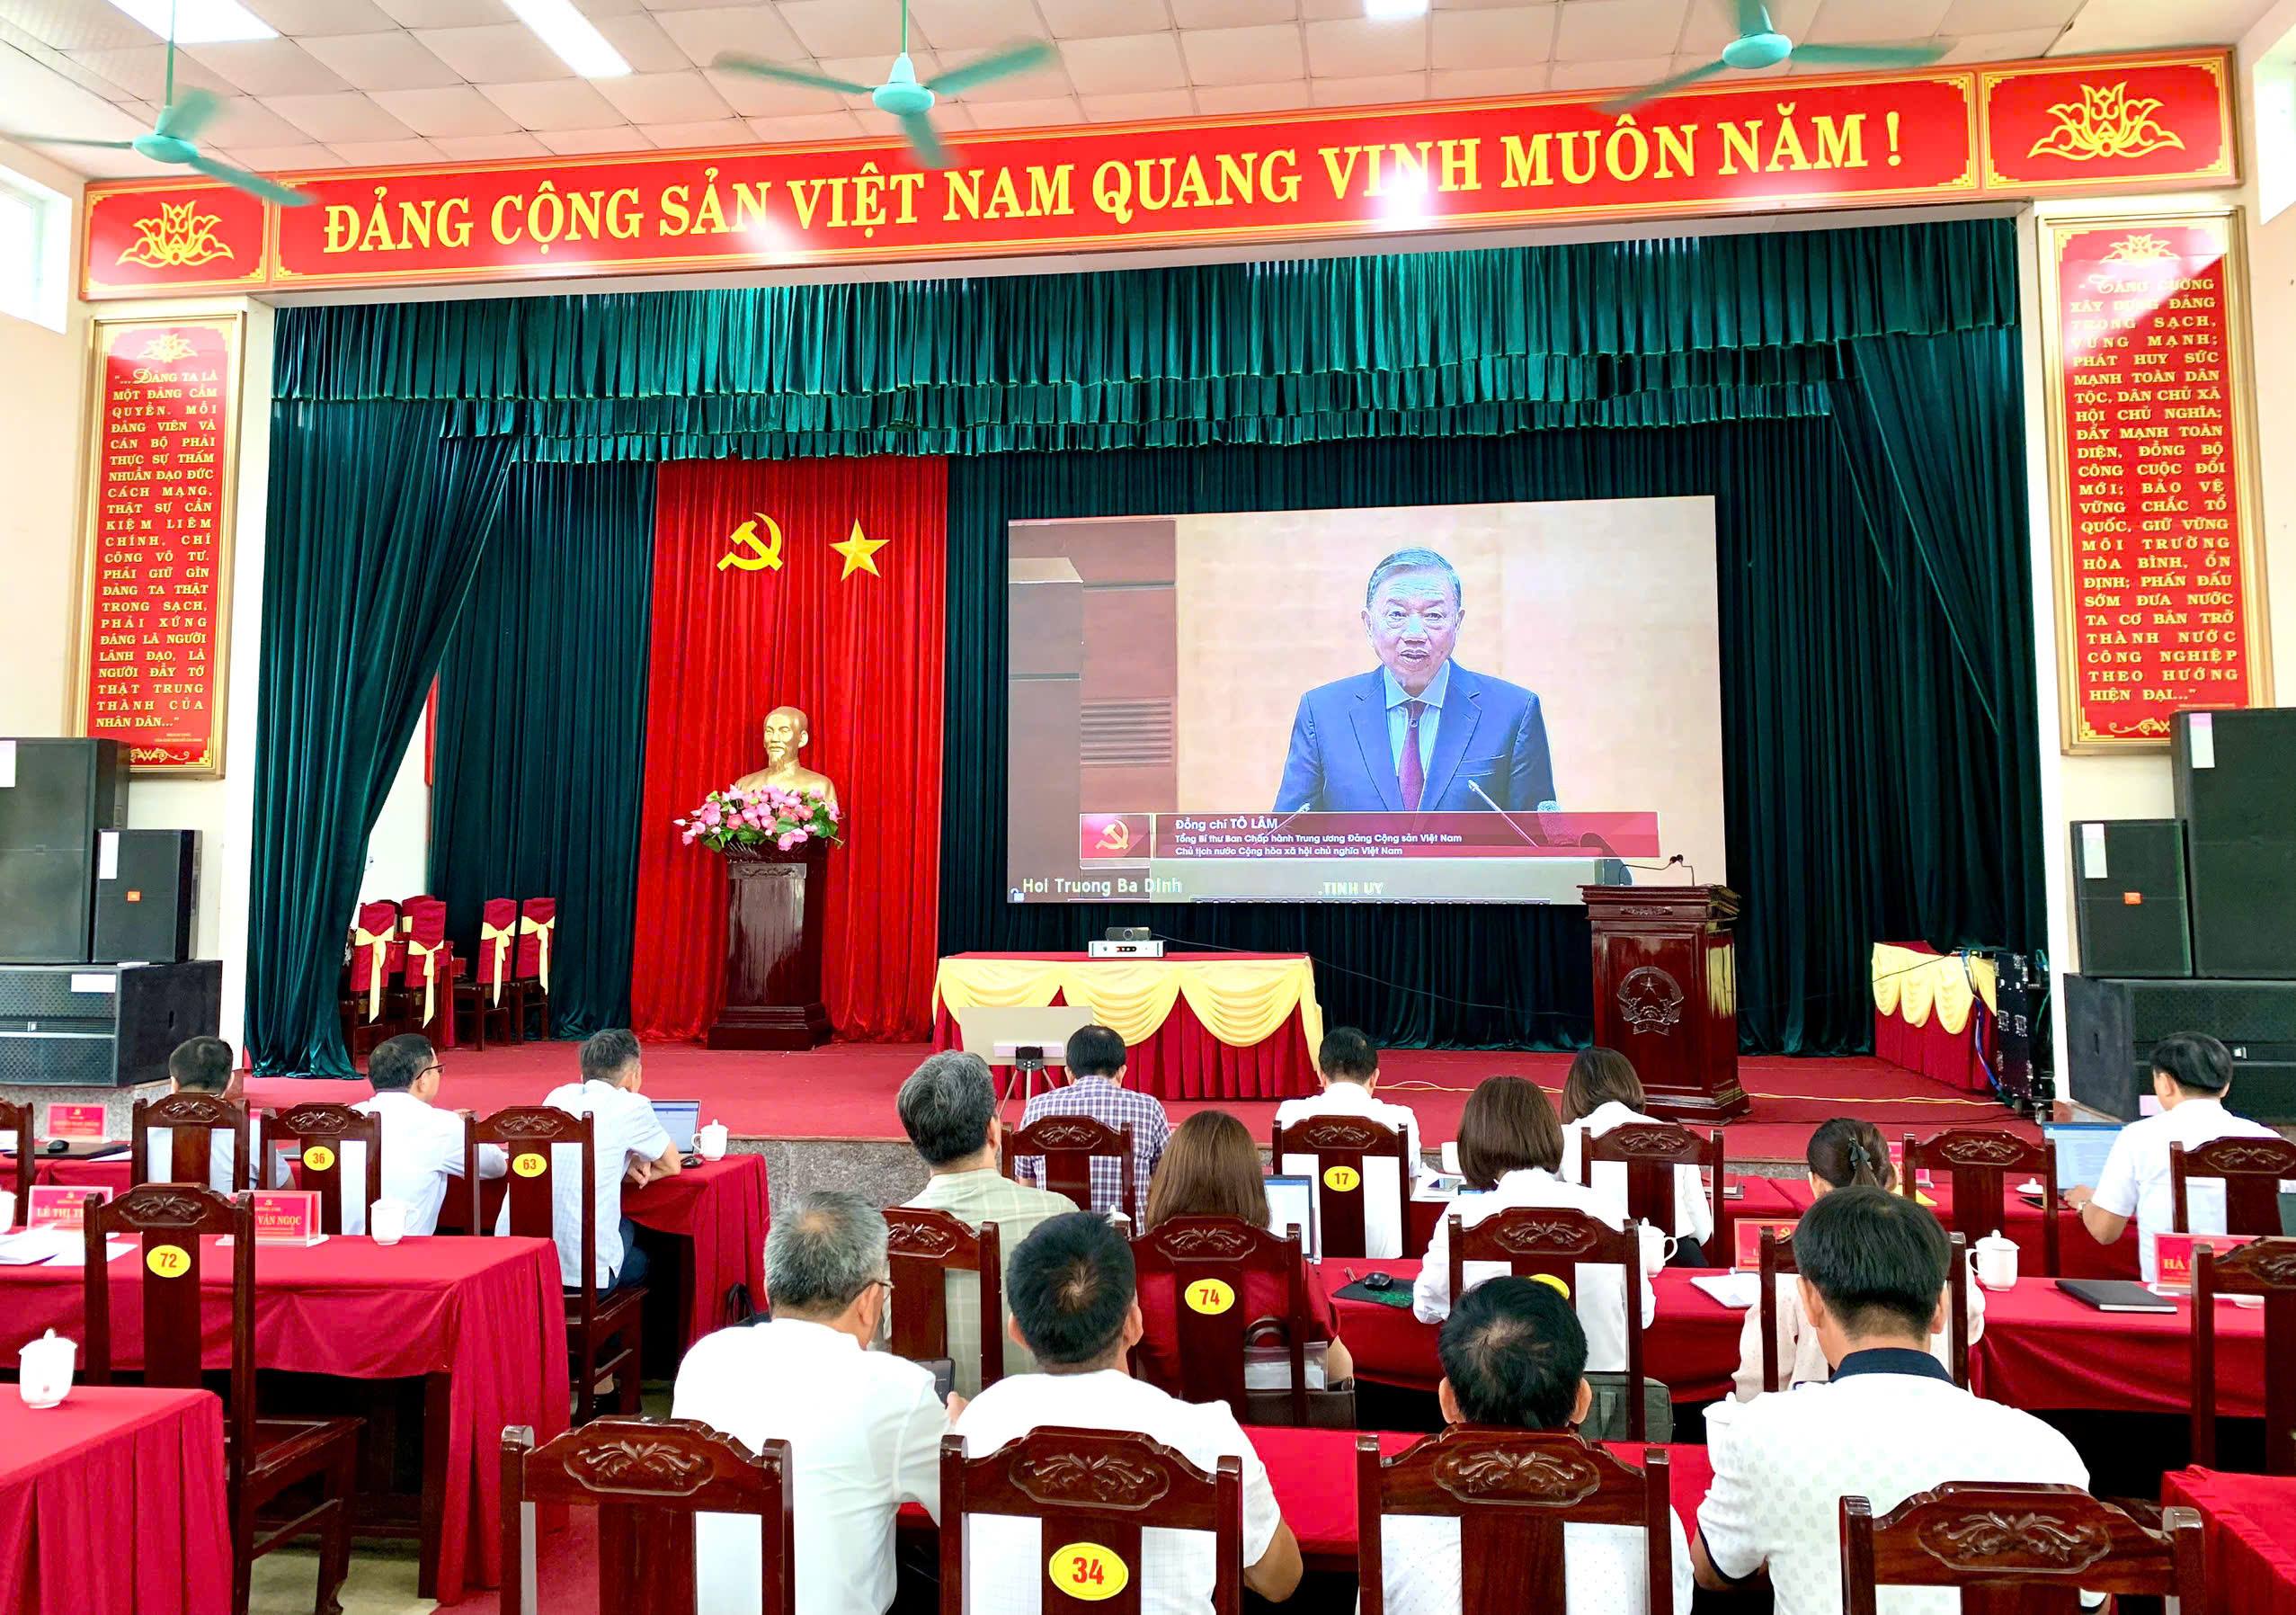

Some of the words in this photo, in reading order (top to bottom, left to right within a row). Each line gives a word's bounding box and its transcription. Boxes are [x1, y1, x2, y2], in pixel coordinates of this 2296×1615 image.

[323, 186, 474, 254] ĐẢNG
[491, 181, 644, 255] CỘNG
[659, 167, 775, 236] SẢN
[786, 162, 924, 238] VIỆT
[943, 165, 1074, 221] NAM
[1092, 149, 1302, 224] QUANG
[1318, 138, 1482, 200] VINH
[1500, 116, 1698, 188] MUÔN
[1717, 103, 1868, 175] NĂM
[2169, 295, 2215, 309] ĐẢNG
[2073, 354, 2118, 367] PHÁT
[2133, 354, 2168, 365] HUY
[2185, 350, 2219, 363] SỨC
[182, 372, 199, 381] TA
[2074, 373, 2122, 387] MẠNH
[2131, 370, 2176, 383] TOÀN
[2185, 369, 2220, 381] DÂN
[113, 388, 140, 401] MỘT
[147, 387, 182, 398] ĐẢNG
[2118, 388, 2151, 402] DÂN
[2158, 386, 2192, 401] CHỦ
[2076, 409, 2105, 423] HỘI
[2118, 406, 2151, 420] CHỦ
[111, 420, 146, 433] ĐẢNG
[157, 420, 187, 431] VIÊN
[199, 418, 216, 430] VÀ
[2120, 427, 2169, 441] MẠNH
[2179, 424, 2222, 437] TOÀN
[111, 438, 138, 449] CÁN
[151, 436, 168, 449] BỘ
[182, 434, 215, 447] PHẢI
[2201, 442, 2223, 458] BỘ
[111, 455, 144, 467] THỰC
[152, 453, 169, 465] SỰ
[177, 450, 214, 463] THẤM
[156, 470, 182, 481] ĐẠO
[187, 468, 213, 479] ĐỨC
[2078, 464, 2123, 477] CÔNG
[2137, 461, 2182, 477] CUỘC
[108, 486, 149, 498] CÁCH
[2142, 479, 2181, 493] BẢO
[2199, 479, 2224, 494] VỆ
[107, 502, 142, 515] THẬT
[155, 502, 173, 514] SỰ
[2080, 501, 2125, 513] VỮNG
[106, 518, 152, 531] KIỆM
[166, 517, 211, 528] LIÊM
[2142, 518, 2172, 531] GIỮ
[2182, 518, 2229, 531] VỮNG
[182, 532, 210, 545] CHÍ
[2082, 538, 2122, 550] MÔI
[2142, 536, 2229, 549] TRƯỜNG
[105, 551, 143, 563] CÔNG
[156, 550, 173, 561] VÔ
[2083, 557, 2122, 569] HÒA
[103, 567, 137, 579] PHẢI
[149, 567, 173, 577] GIỮ
[186, 566, 209, 577] GÌN
[2141, 572, 2185, 587] PHẤN
[2197, 572, 2231, 586] ĐẤU
[102, 583, 138, 595] ĐẢNG
[148, 585, 165, 594] TA
[174, 583, 209, 596] THẬT
[2085, 593, 2121, 607] SỚM
[2137, 593, 2172, 606] ĐƯA
[2187, 592, 2233, 604] NƯỚC
[102, 602, 149, 611] TRONG
[163, 602, 207, 612] SẠCH,
[101, 615, 144, 629] PHẢI
[159, 615, 207, 627] XỨNG
[2086, 615, 2107, 626] TA
[2119, 612, 2141, 625] CƠ
[2153, 610, 2187, 624] BẢN
[2200, 610, 2234, 624] TRỞ
[143, 632, 159, 644] LÀ
[166, 632, 206, 643] NGƯỜI
[2087, 630, 2159, 644] THÀNH
[2178, 629, 2236, 643] NƯỚC
[100, 649, 133, 661] LÃNH
[189, 648, 205, 660] LÀ
[2087, 649, 2142, 663] CÔNG
[2159, 648, 2237, 664] NGHIỆP
[99, 665, 138, 677] NGƯỜI
[188, 665, 204, 677] TỚ
[2088, 671, 2143, 682] THEO
[2162, 668, 2238, 681] HƯỚNG
[98, 683, 139, 695] THẬT
[153, 684, 203, 693] TRUNG
[2089, 687, 2131, 702] HIỆN
[97, 699, 154, 711] THÀNH
[169, 697, 203, 709] CỦA
[96, 715, 131, 727] NHÂN
[1175, 816, 1206, 831] Đồng
[1209, 819, 1227, 829] chí
[1230, 816, 1247, 829] TÔ
[1251, 816, 1278, 829] LÂM
[1175, 833, 1197, 844] Tổng
[1209, 834, 1224, 843] thư
[1245, 834, 1268, 843] Chấp
[1271, 834, 1294, 843] hành
[1295, 834, 1320, 843] Trung
[1348, 834, 1372, 843] Đảng
[1375, 834, 1399, 843] Cộng
[1402, 834, 1418, 842] sản
[1420, 834, 1437, 843] Việt
[1175, 846, 1193, 855] Chủ
[1196, 847, 1212, 857] tịch
[1239, 847, 1262, 856] Cộng
[1265, 846, 1282, 855] hòa
[1285, 847, 1295, 855] xã
[1299, 847, 1312, 856] hội
[1314, 846, 1331, 854] chủ
[1333, 847, 1358, 856] nghĩa
[1362, 847, 1379, 856] Việt
[1023, 879, 1047, 893] Hoi
[1055, 879, 1111, 897] Truong
[1118, 879, 1137, 893] Ba
[1145, 879, 1182, 893] Dinh
[312, 1153, 325, 1164] 36
[522, 1158, 537, 1171] 63
[1334, 1173, 1348, 1185] 17
[159, 1253, 177, 1269] 72
[1199, 1289, 1221, 1306] 74
[1072, 1557, 1105, 1585] 34
